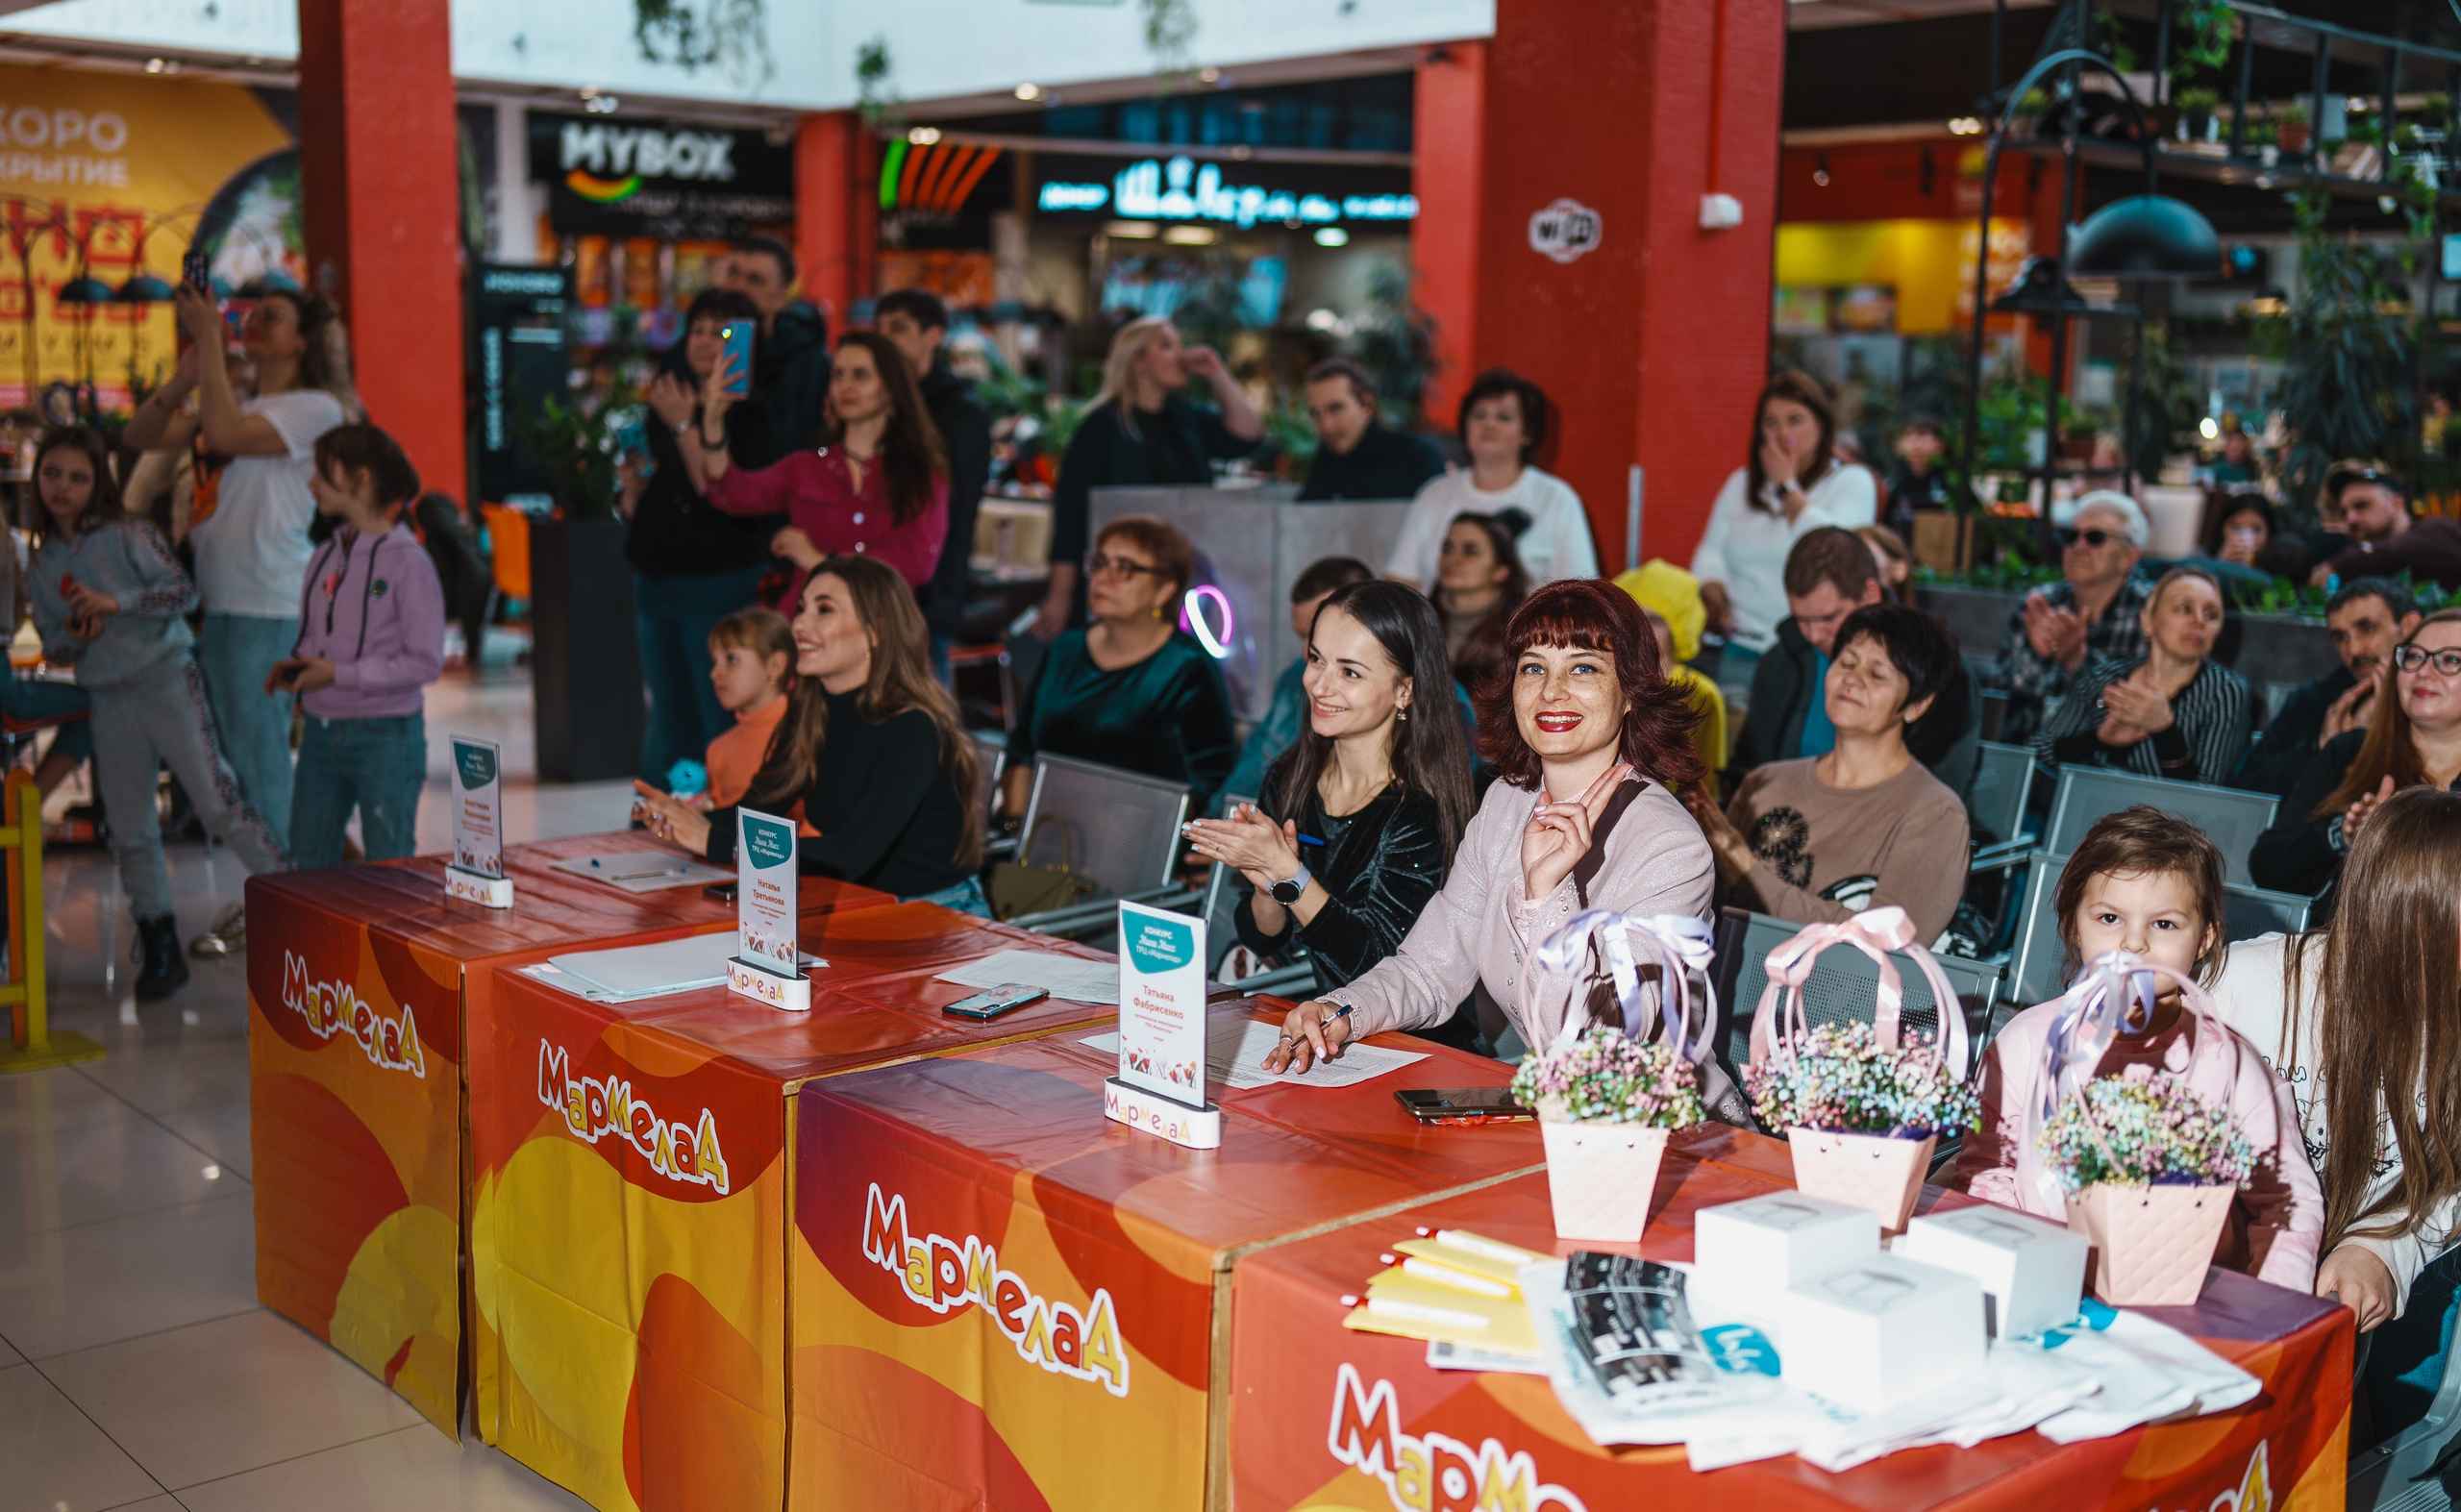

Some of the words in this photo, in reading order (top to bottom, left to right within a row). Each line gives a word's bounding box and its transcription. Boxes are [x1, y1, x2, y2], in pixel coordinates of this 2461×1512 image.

[0, 104, 128, 153] ОРО
[560, 121, 734, 182] MYBOX
[758, 879, 780, 892] Наталья
[753, 889, 784, 905] Третьякова
[1144, 926, 1173, 940] КОНКУРС
[1135, 945, 1148, 956] ТРЦ
[1143, 984, 1175, 1003] Татьяна
[1133, 997, 1184, 1020] Фабрисенко
